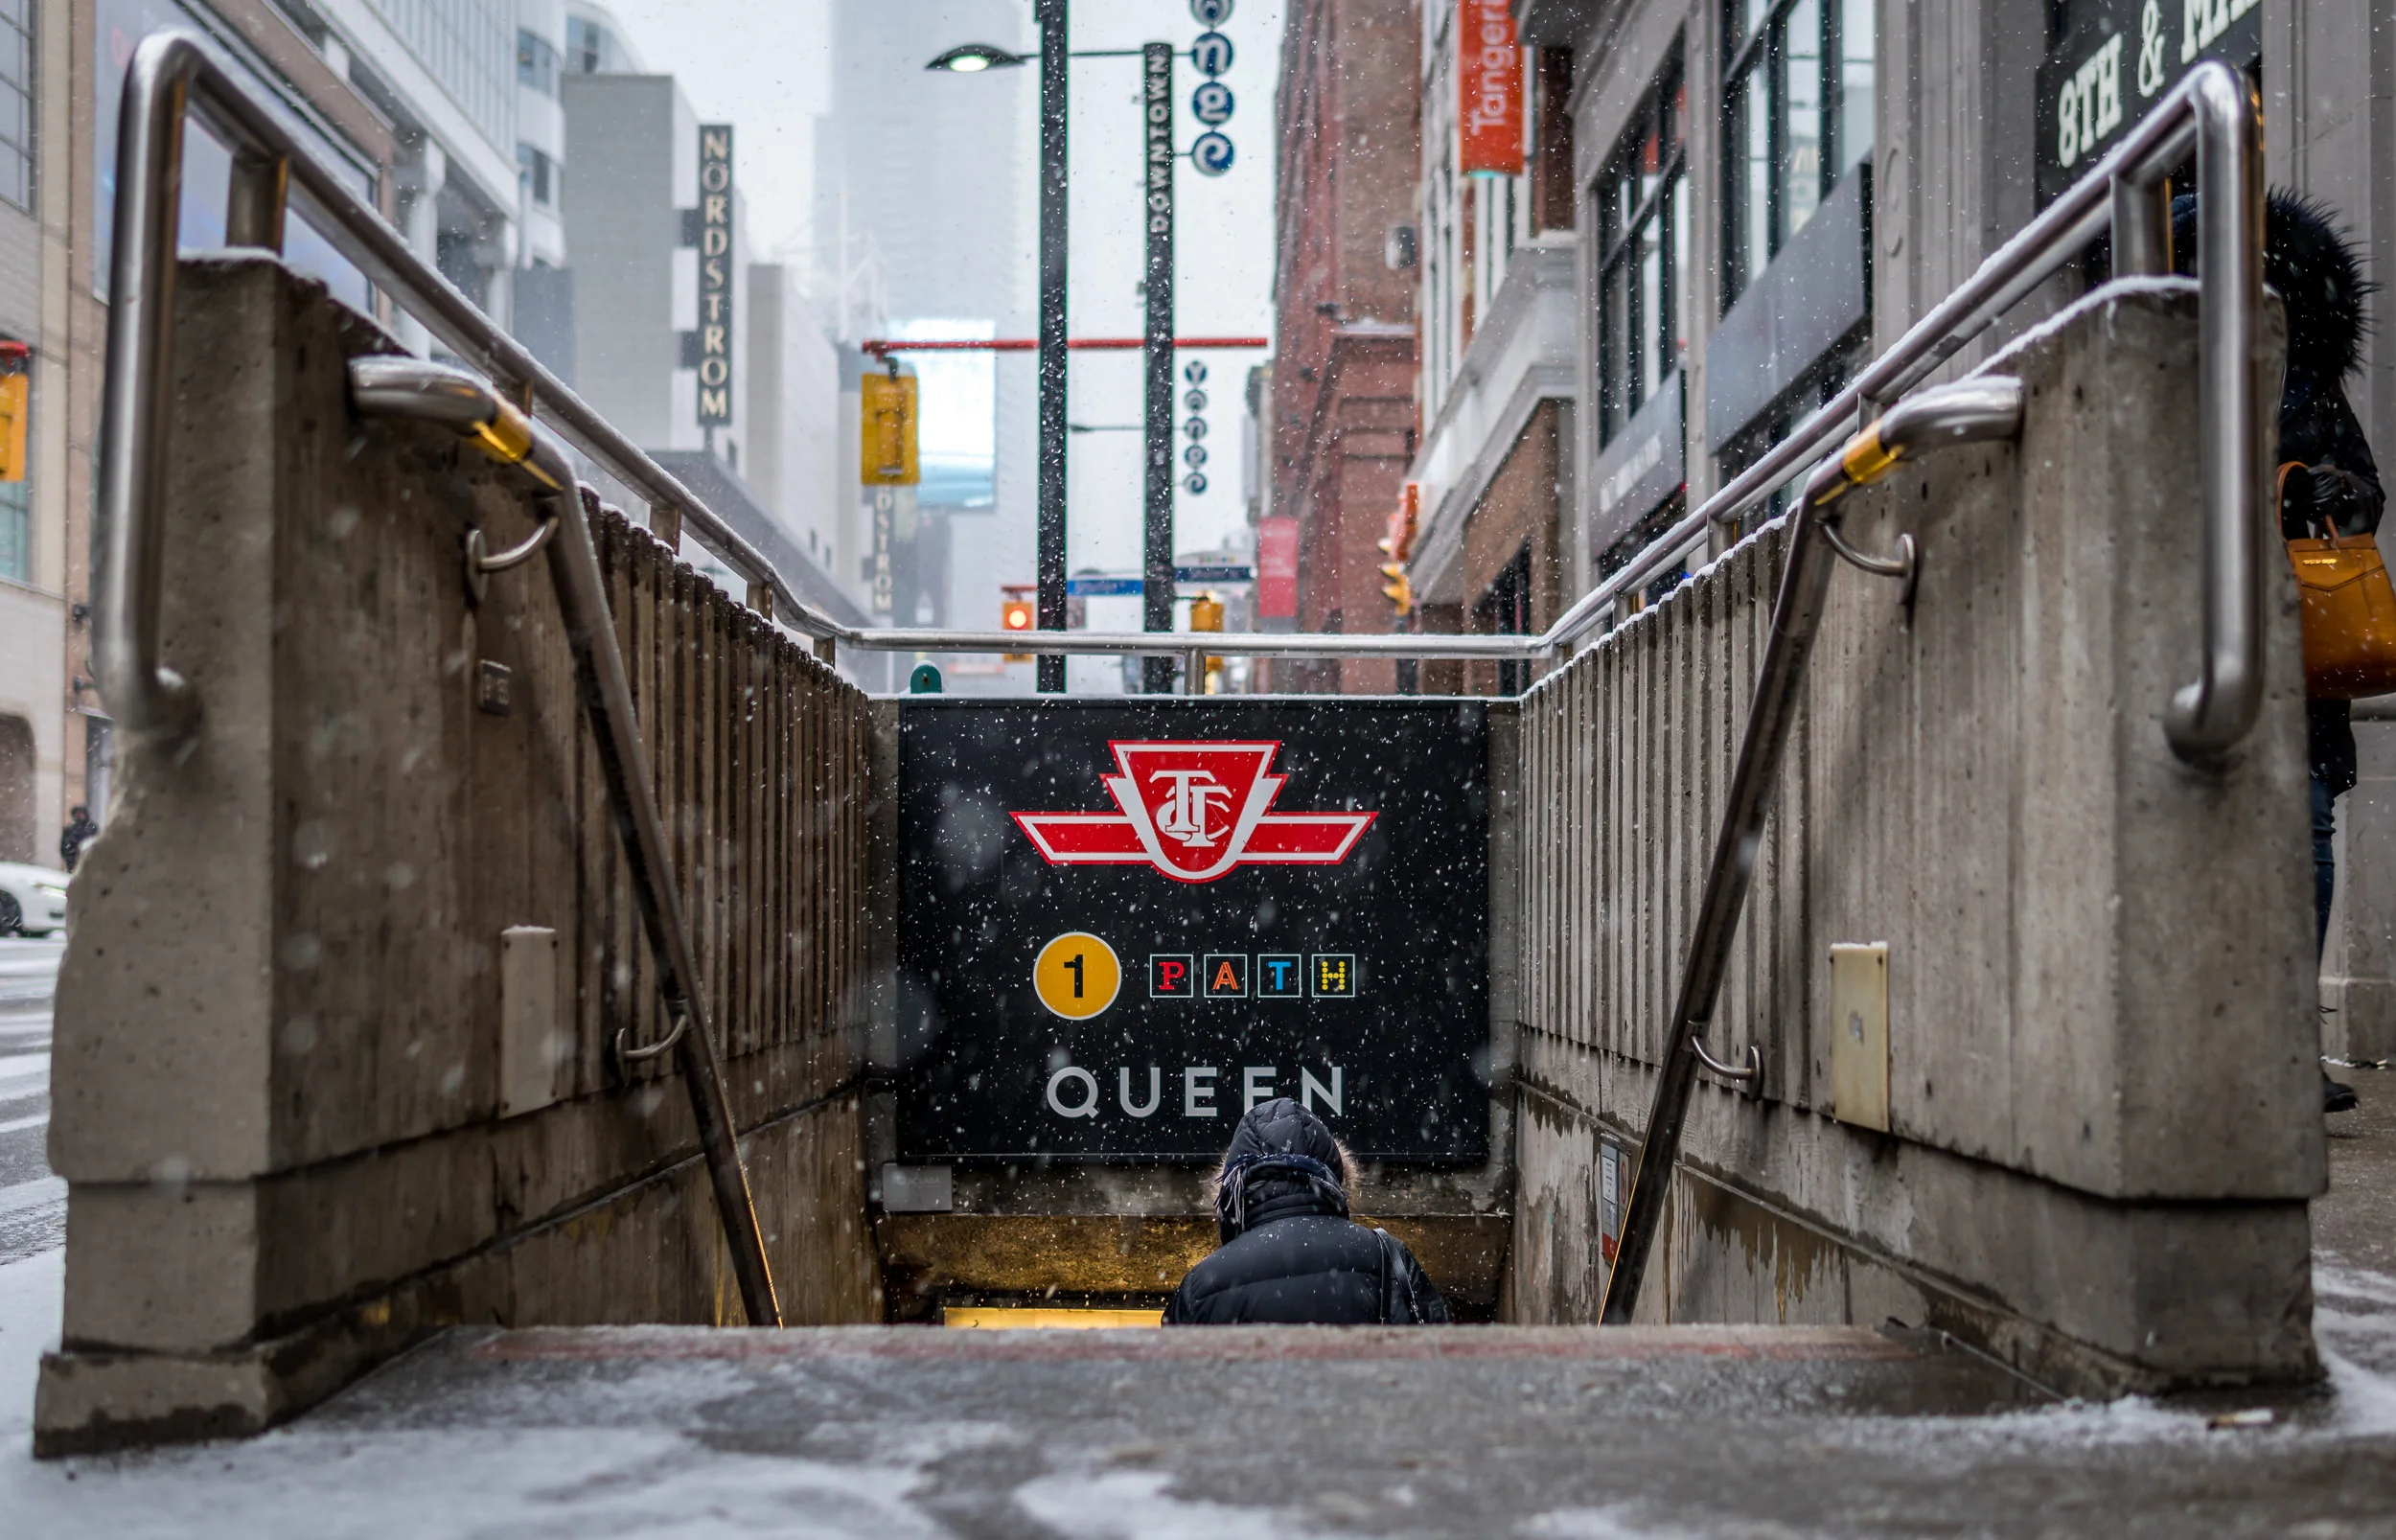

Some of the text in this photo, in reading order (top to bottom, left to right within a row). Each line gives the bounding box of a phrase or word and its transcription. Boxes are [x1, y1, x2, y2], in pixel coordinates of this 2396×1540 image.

[1148, 53, 1170, 234] DOWNTOWN
[2058, 33, 2122, 169] 8TH
[2138, 0, 2165, 98] &
[702, 131, 730, 420] NORDSTROM
[875, 485, 893, 612] DSTROM
[1063, 954, 1346, 999] 1 PATH
[1047, 1065, 1343, 1119] QUEEN
